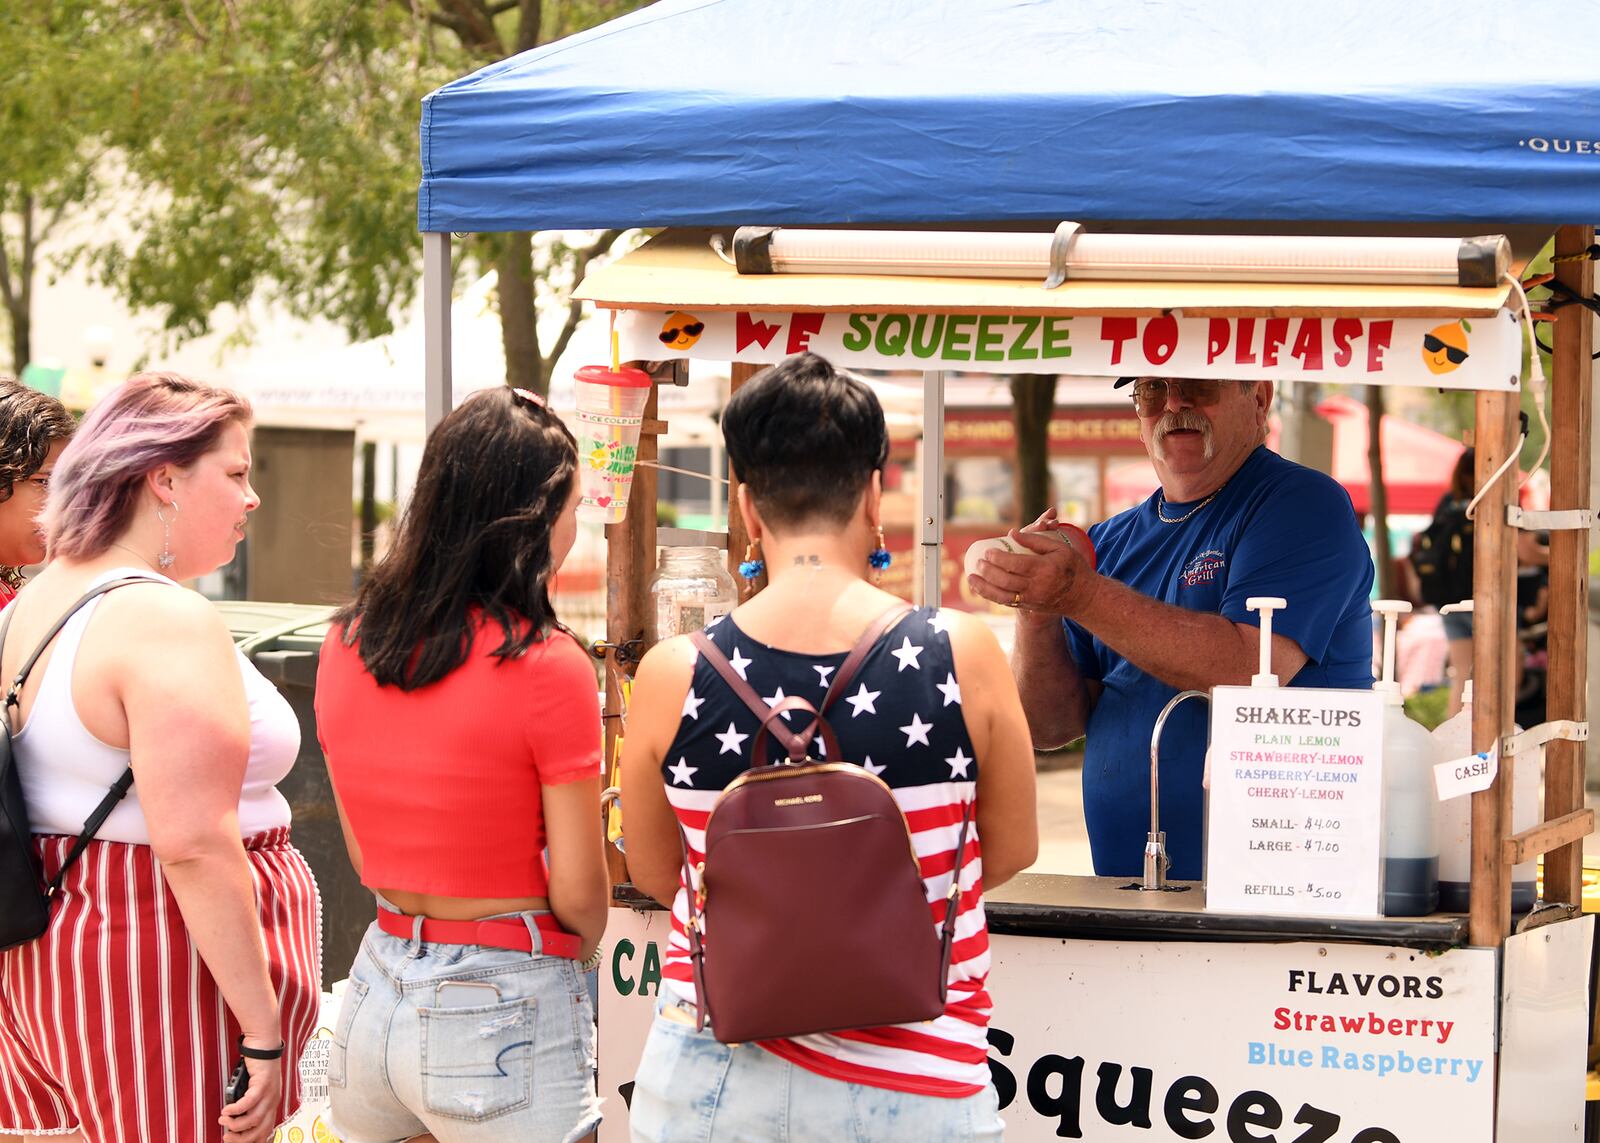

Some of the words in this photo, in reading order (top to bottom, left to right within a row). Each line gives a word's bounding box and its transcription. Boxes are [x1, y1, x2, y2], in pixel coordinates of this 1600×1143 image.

[736, 311, 826, 356] WE
[842, 312, 1075, 362] SQUEEZE
[1101, 315, 1179, 366] TO
[1207, 316, 1394, 373] PLEASE
[1178, 560, 1226, 580] American
[1188, 570, 1214, 586] Grill
[1235, 706, 1362, 728] SHAKE-UPS
[1254, 734, 1292, 745] PLAIN
[1299, 735, 1341, 747] LEMON
[1230, 751, 1364, 766] STRAWBERRY-LEMON
[1235, 769, 1358, 783] RASPBERRY-LEMON
[1454, 762, 1489, 781] CASH
[1247, 787, 1345, 800] CHERRY-LEMON
[1304, 816, 1341, 830] $4.00
[1304, 839, 1341, 853] $7.00
[1306, 883, 1342, 899] $5.00
[1288, 969, 1444, 999] FLAVORS
[1273, 1007, 1455, 1044] Strawberry
[1247, 1041, 1313, 1068] Blue
[1321, 1045, 1484, 1084] Raspberry
[986, 1027, 1402, 1143] Squeez
